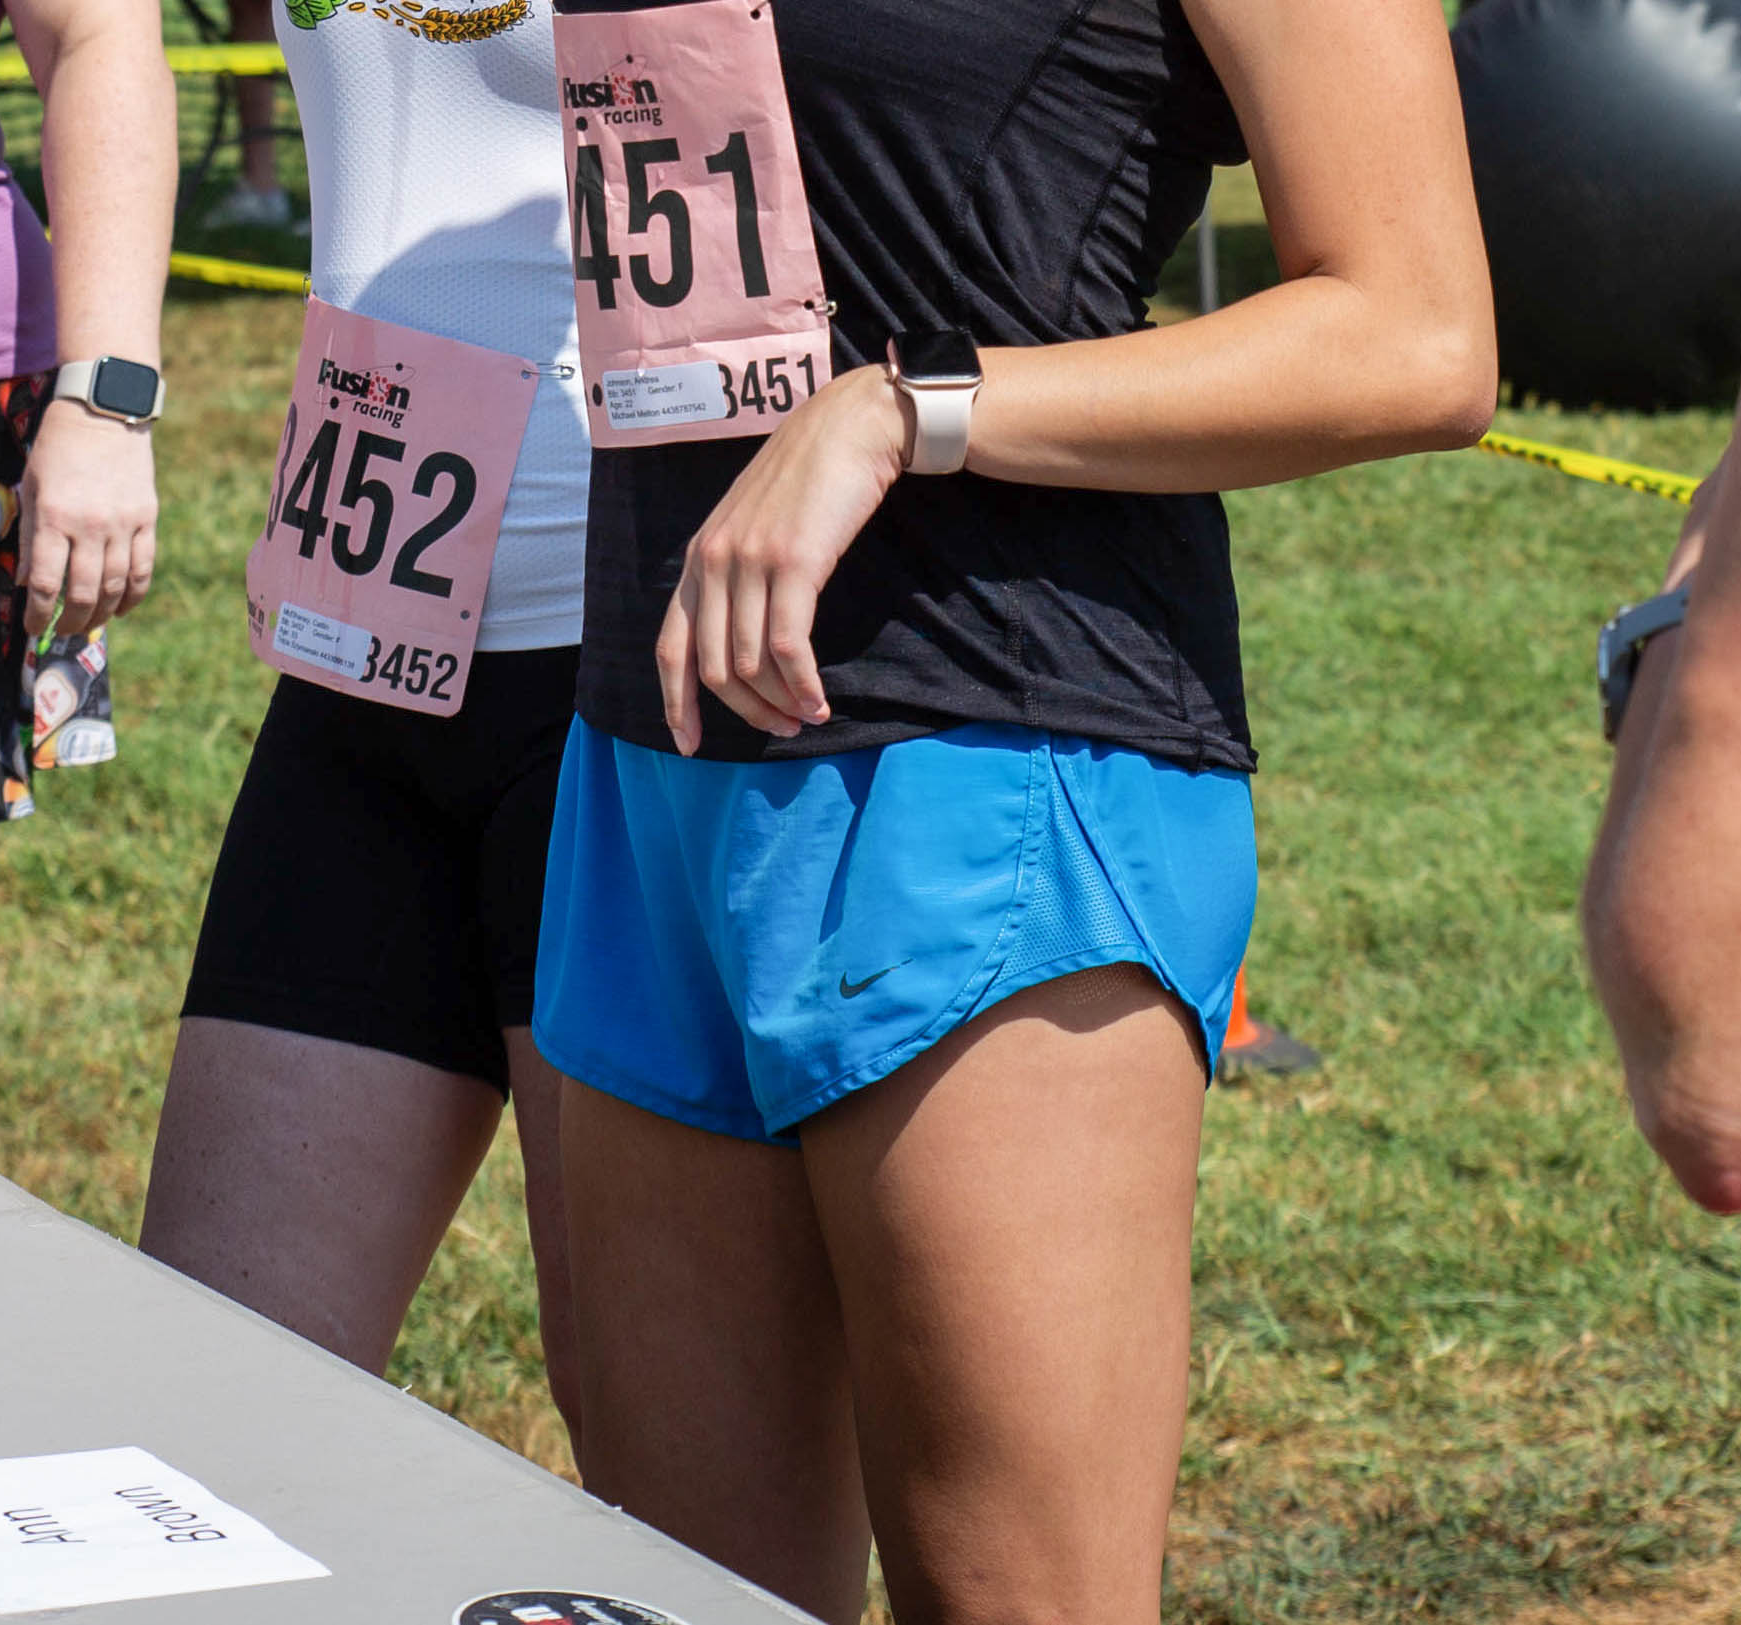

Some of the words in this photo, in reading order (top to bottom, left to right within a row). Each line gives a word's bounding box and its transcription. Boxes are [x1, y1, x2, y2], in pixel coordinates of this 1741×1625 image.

[604, 106, 664, 127] racing
[567, 132, 771, 311] 451
[318, 358, 411, 410] Fusion
[352, 399, 406, 429] racing
[359, 636, 460, 702] 3452
[2, 1505, 89, 1546] Ann
[114, 1484, 228, 1545] Brown
